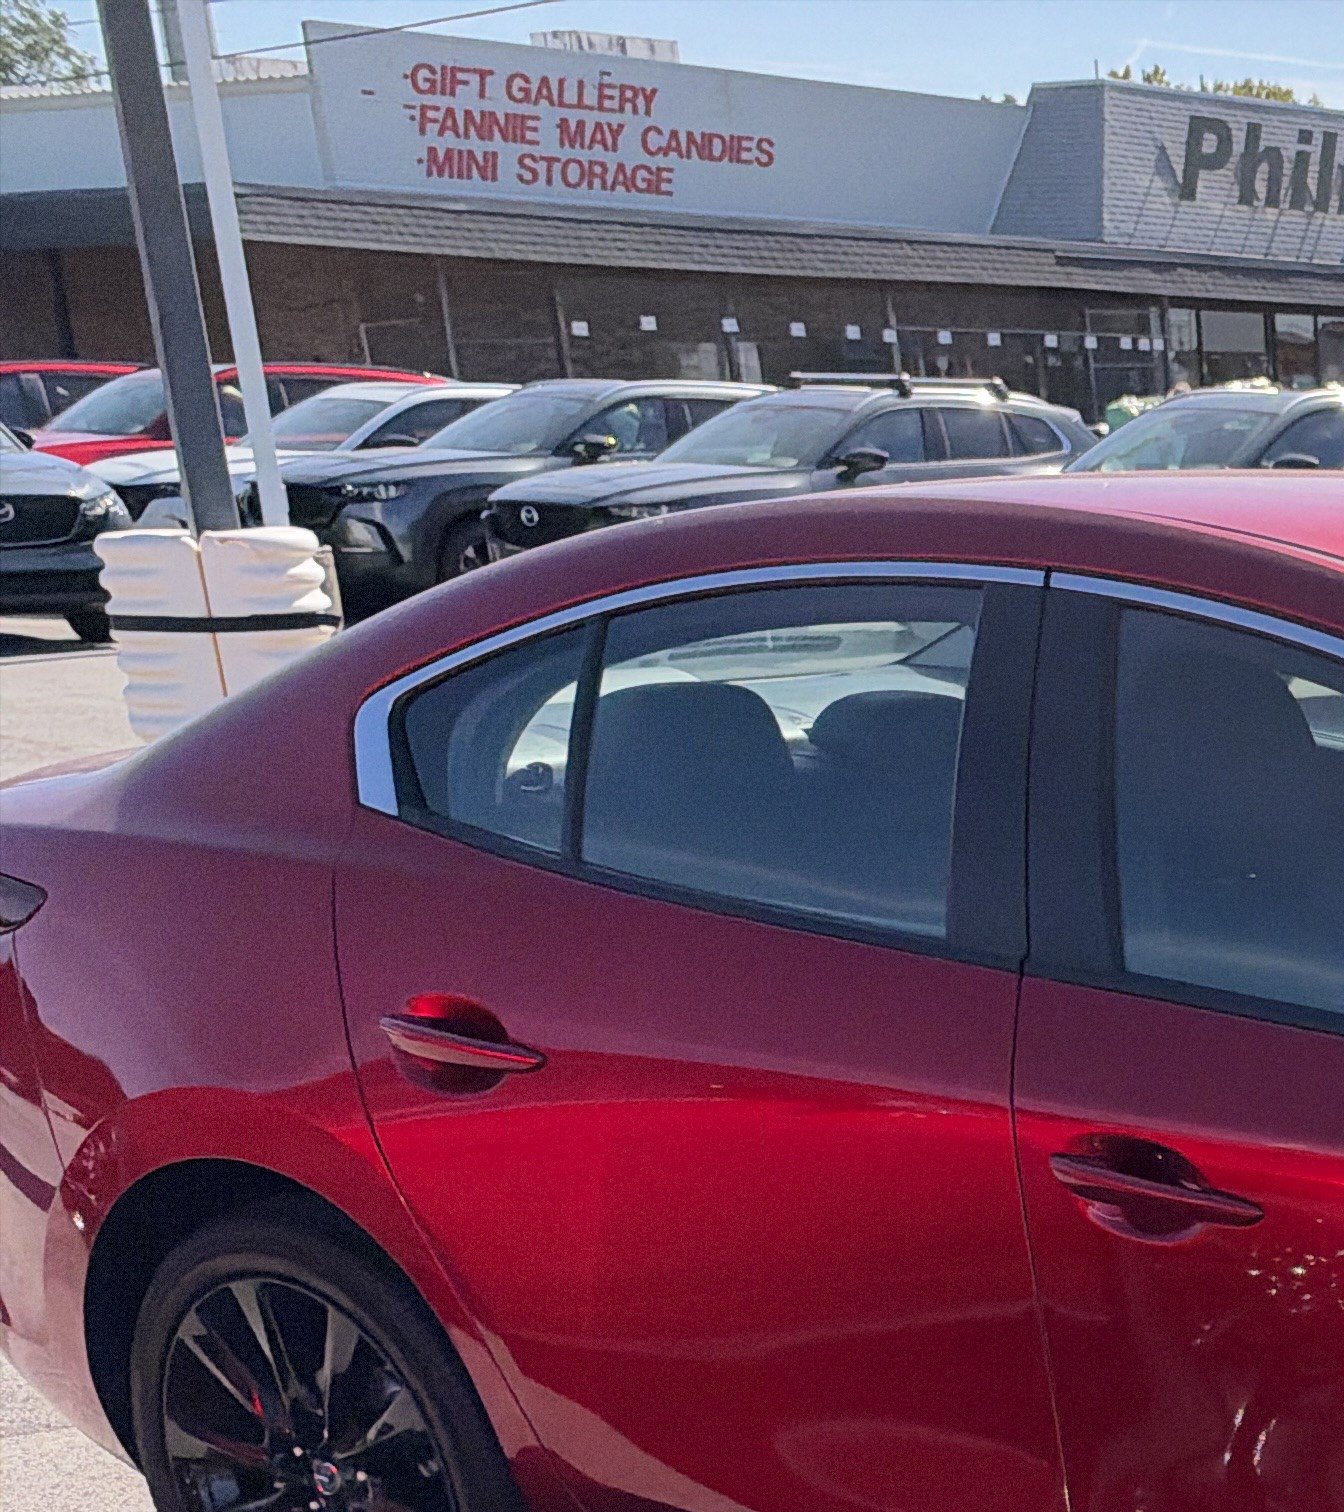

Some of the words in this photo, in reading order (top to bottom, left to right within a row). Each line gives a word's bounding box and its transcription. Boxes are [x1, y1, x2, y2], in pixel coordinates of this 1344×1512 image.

[409, 63, 495, 100] GIFT
[505, 72, 659, 117] GALLERY
[418, 103, 542, 146] FANNIE
[558, 117, 626, 153] MAY
[641, 125, 776, 168] CANDIES
[425, 146, 499, 183] MINI
[516, 153, 675, 197] STORAGE
